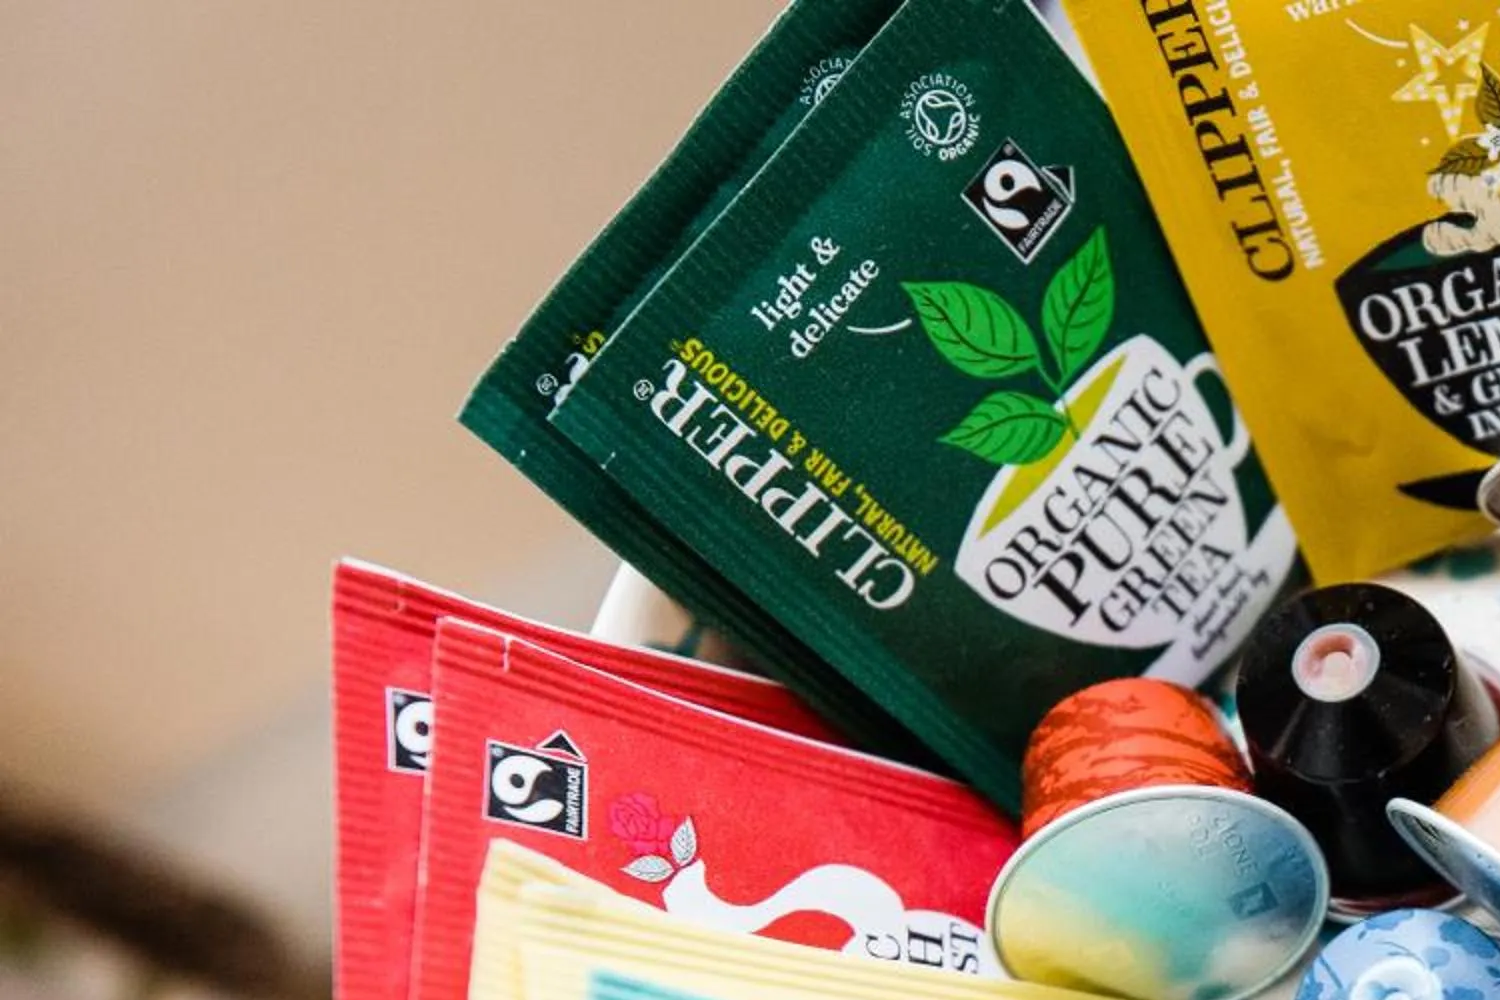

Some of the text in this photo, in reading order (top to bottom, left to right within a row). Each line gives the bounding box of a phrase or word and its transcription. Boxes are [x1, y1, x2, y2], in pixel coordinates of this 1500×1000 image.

[899, 73, 976, 157] SOIL ASSOCIATION
[1237, 80, 1260, 100] &
[938, 113, 982, 161] ORGANIC
[1247, 105, 1282, 159] FAIR
[1017, 198, 1064, 252] FAIRTRADE
[751, 236, 841, 331] light &
[789, 259, 880, 358] delicate
[1432, 383, 1465, 416] &
[786, 430, 808, 455] &
[804, 447, 853, 498] FAIR
[984, 367, 1182, 600] ORGANIC
[1032, 409, 1215, 627] PURE
[853, 482, 940, 577] NATURAL,
[1097, 467, 1230, 632] GREEN
[1150, 542, 1234, 622] TEA
[565, 766, 581, 834] FAIRTRADE
